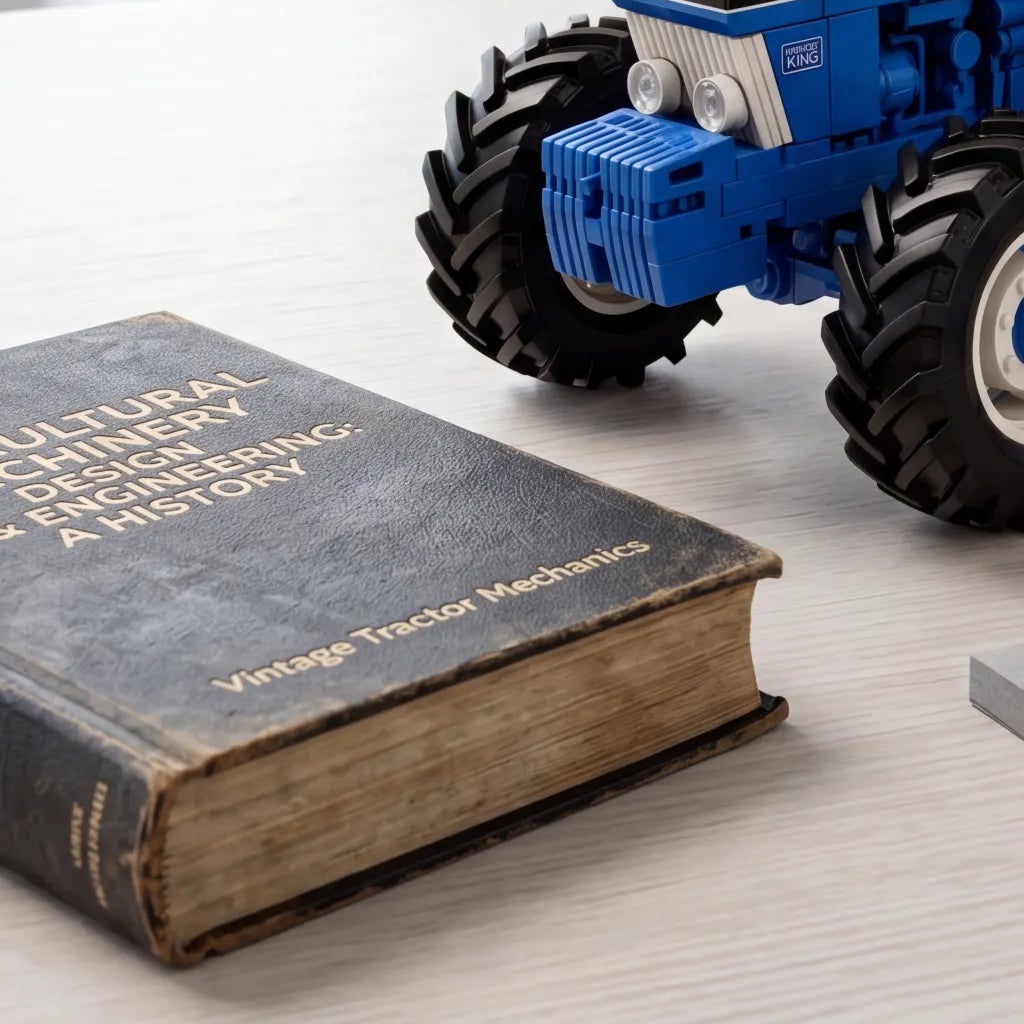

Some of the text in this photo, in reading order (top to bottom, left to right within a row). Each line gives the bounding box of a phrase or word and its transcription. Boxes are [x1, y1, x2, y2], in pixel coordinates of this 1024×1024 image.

[787, 51, 819, 69] KING
[0, 370, 269, 456] ULTURAL
[0, 397, 250, 488] CHINERY
[13, 440, 206, 503] DESIGN
[24, 421, 364, 527] ENGINEERING:
[59, 457, 307, 549] A HISTORY
[210, 537, 651, 695] Vintage Tractor Mechanics
